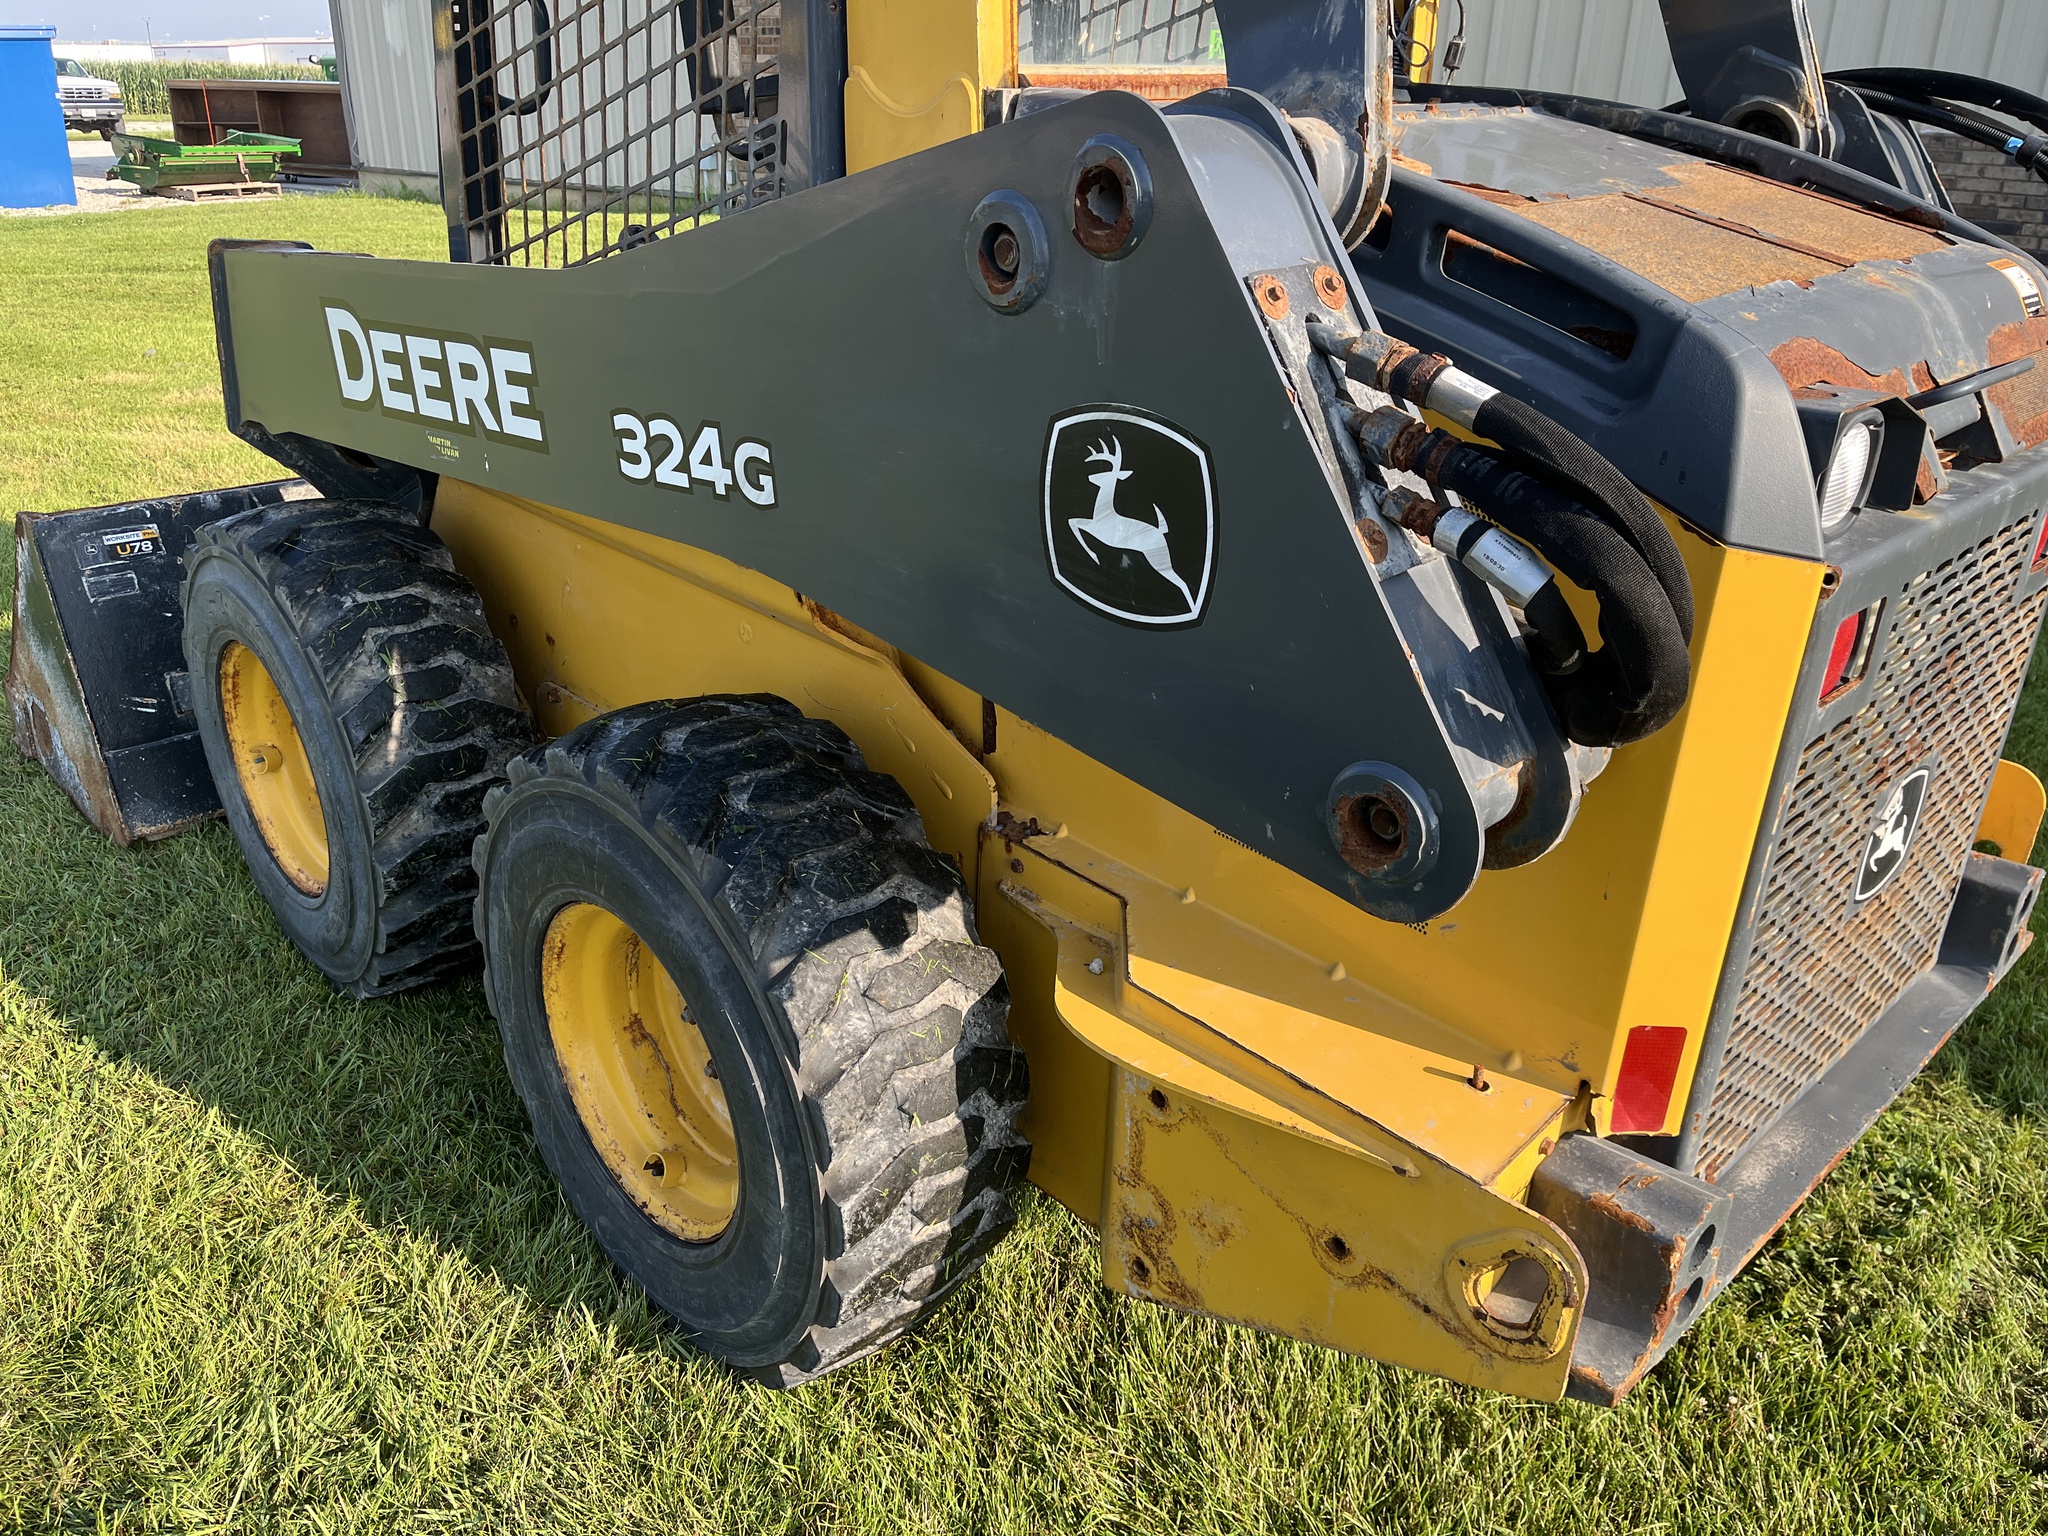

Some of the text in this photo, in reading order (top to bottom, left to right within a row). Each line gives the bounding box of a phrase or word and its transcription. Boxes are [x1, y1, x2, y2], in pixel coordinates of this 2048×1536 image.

[325, 307, 543, 442] DEERE
[612, 413, 776, 506] 324G
[105, 533, 141, 542] WORKSITE
[116, 540, 153, 555] U78
